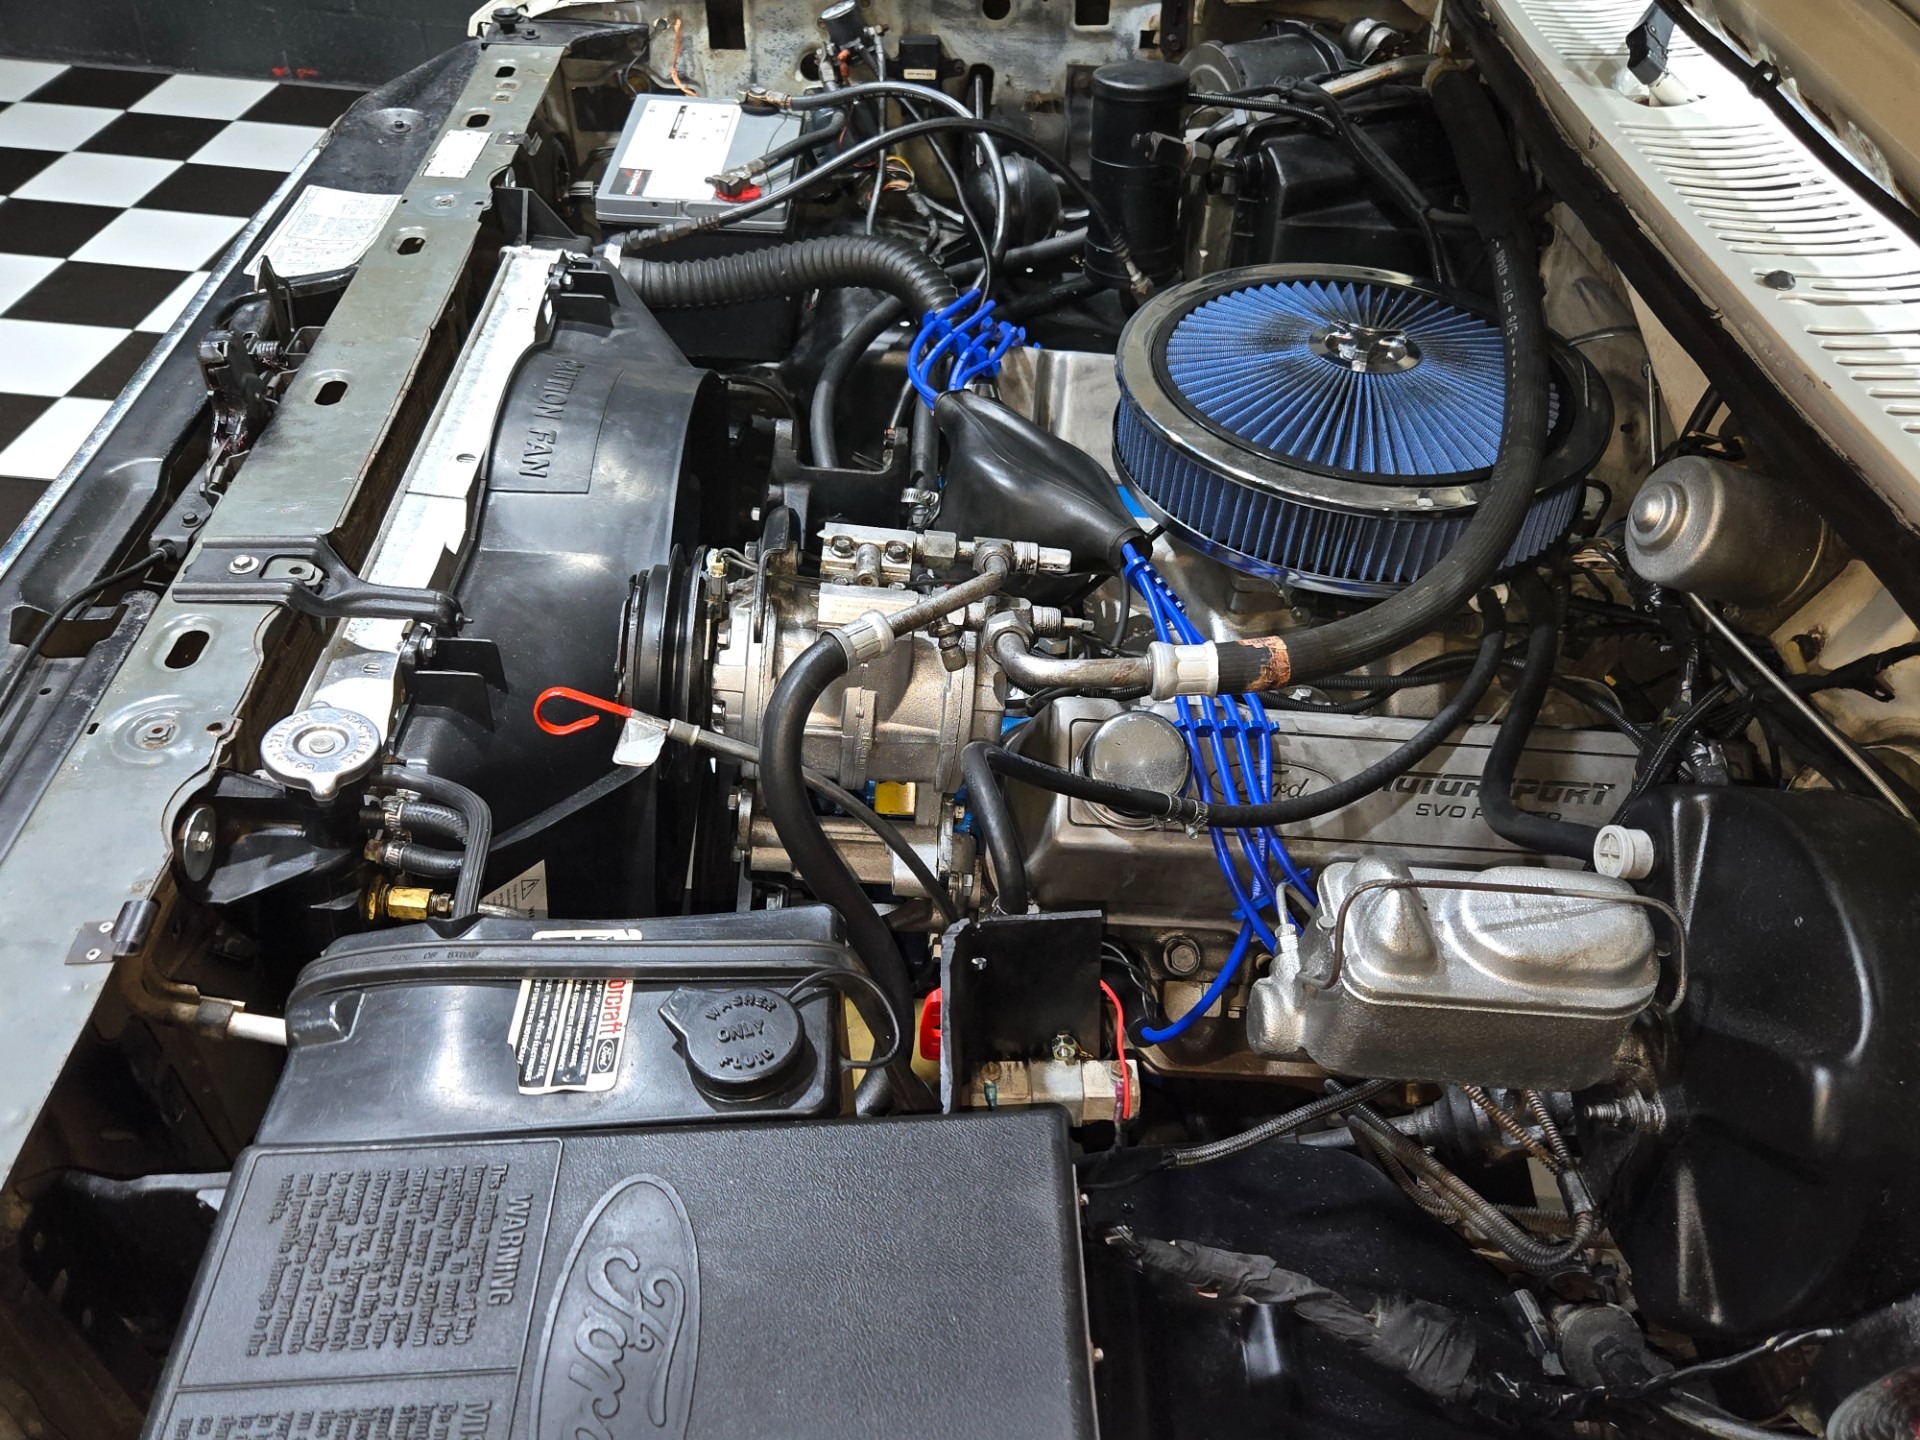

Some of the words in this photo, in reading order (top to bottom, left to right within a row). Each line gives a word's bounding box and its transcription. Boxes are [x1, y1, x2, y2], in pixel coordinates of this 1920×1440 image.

[535, 358, 586, 421] AUTION
[519, 427, 558, 479] FAN
[1381, 770, 1616, 806] OTORPORT
[1416, 803, 1466, 820] SVO
[599, 977, 626, 1036] orcraft
[705, 993, 778, 1021] WASHER
[717, 1018, 765, 1043] ONLY
[719, 1048, 775, 1070] FLUID
[486, 1163, 509, 1190] This
[485, 1193, 534, 1307] WARNING
